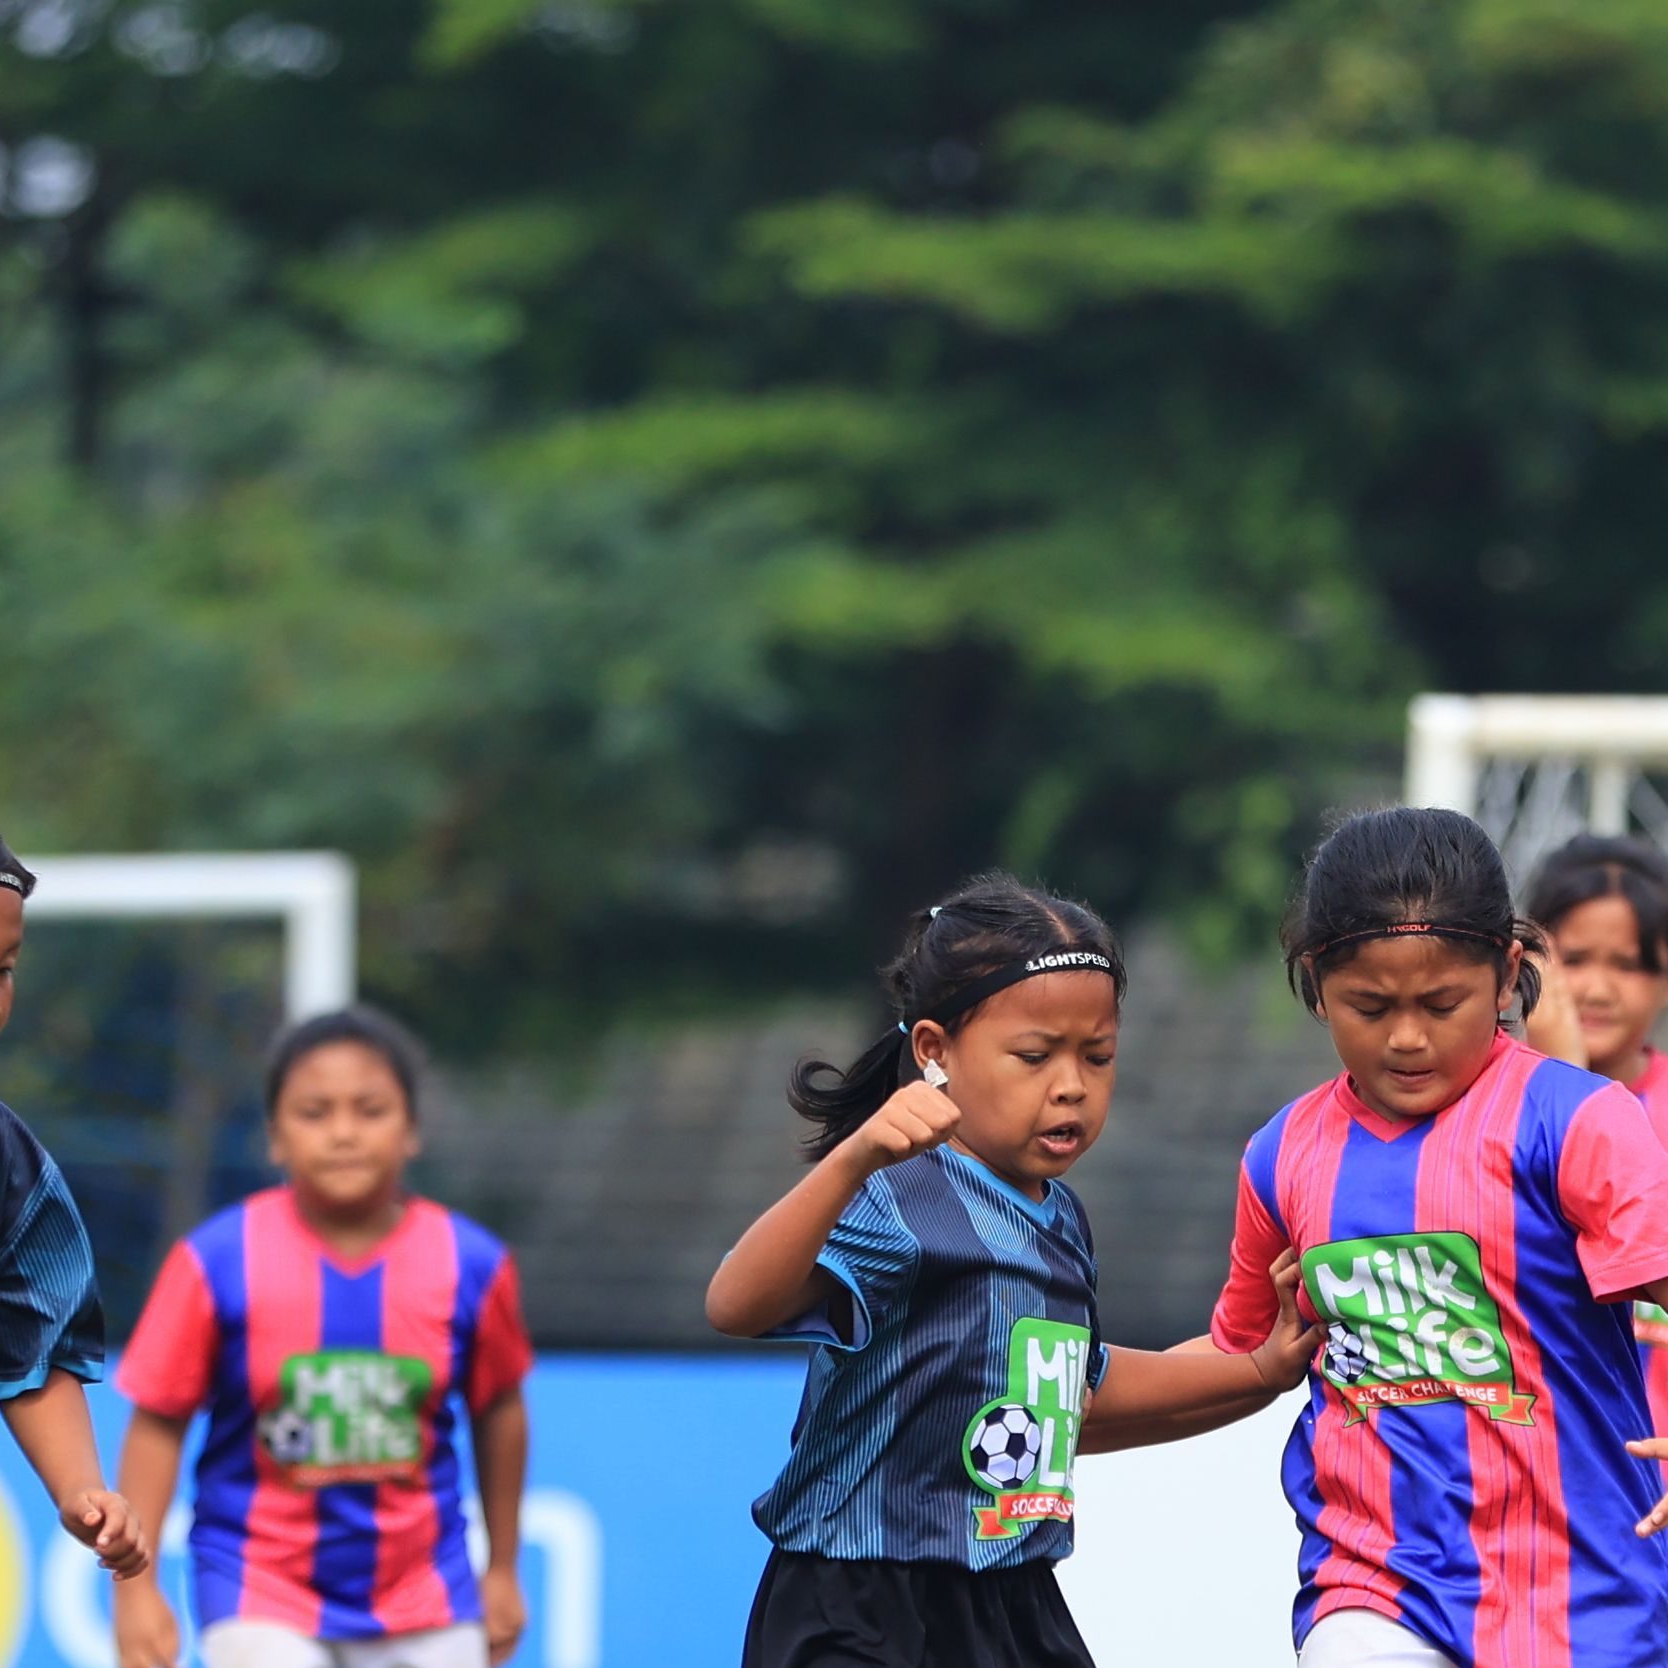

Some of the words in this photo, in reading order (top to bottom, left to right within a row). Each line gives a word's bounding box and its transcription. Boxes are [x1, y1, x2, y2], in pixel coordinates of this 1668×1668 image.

[1027, 952, 1111, 971] LIGHTSPEED
[1315, 1246, 1476, 1319] Milk
[1027, 1337, 1090, 1416] Mil
[1359, 1310, 1501, 1380] Life
[1357, 1386, 1409, 1403] SOCER
[1411, 1381, 1498, 1402] CHAENGE
